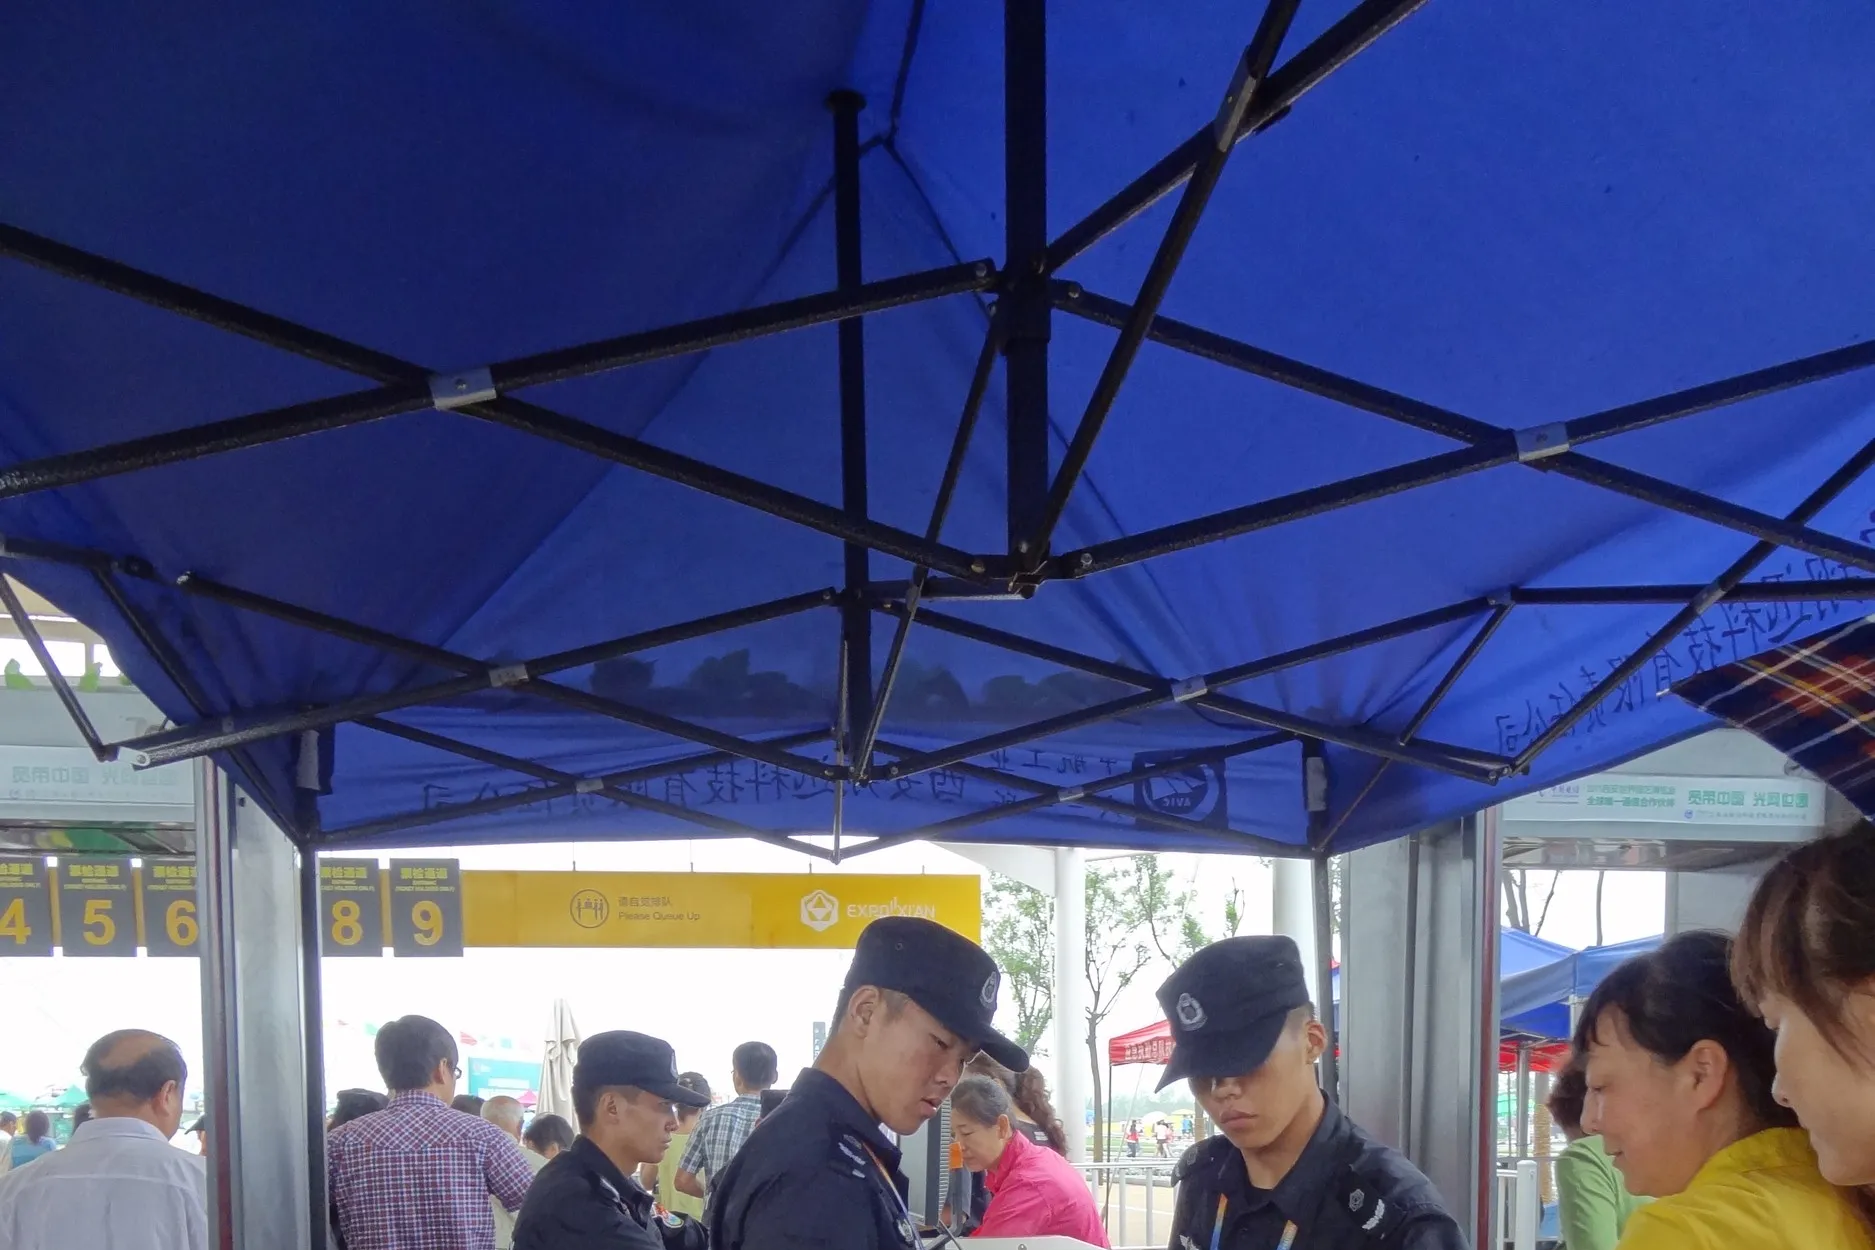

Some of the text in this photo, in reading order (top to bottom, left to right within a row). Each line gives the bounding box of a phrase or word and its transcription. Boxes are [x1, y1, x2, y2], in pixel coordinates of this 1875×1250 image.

[0, 897, 32, 945] 4
[83, 898, 117, 946] 5
[165, 899, 200, 947] 6
[331, 899, 363, 946] 8
[411, 900, 444, 946] 9
[618, 911, 701, 922] Please Queue Up
